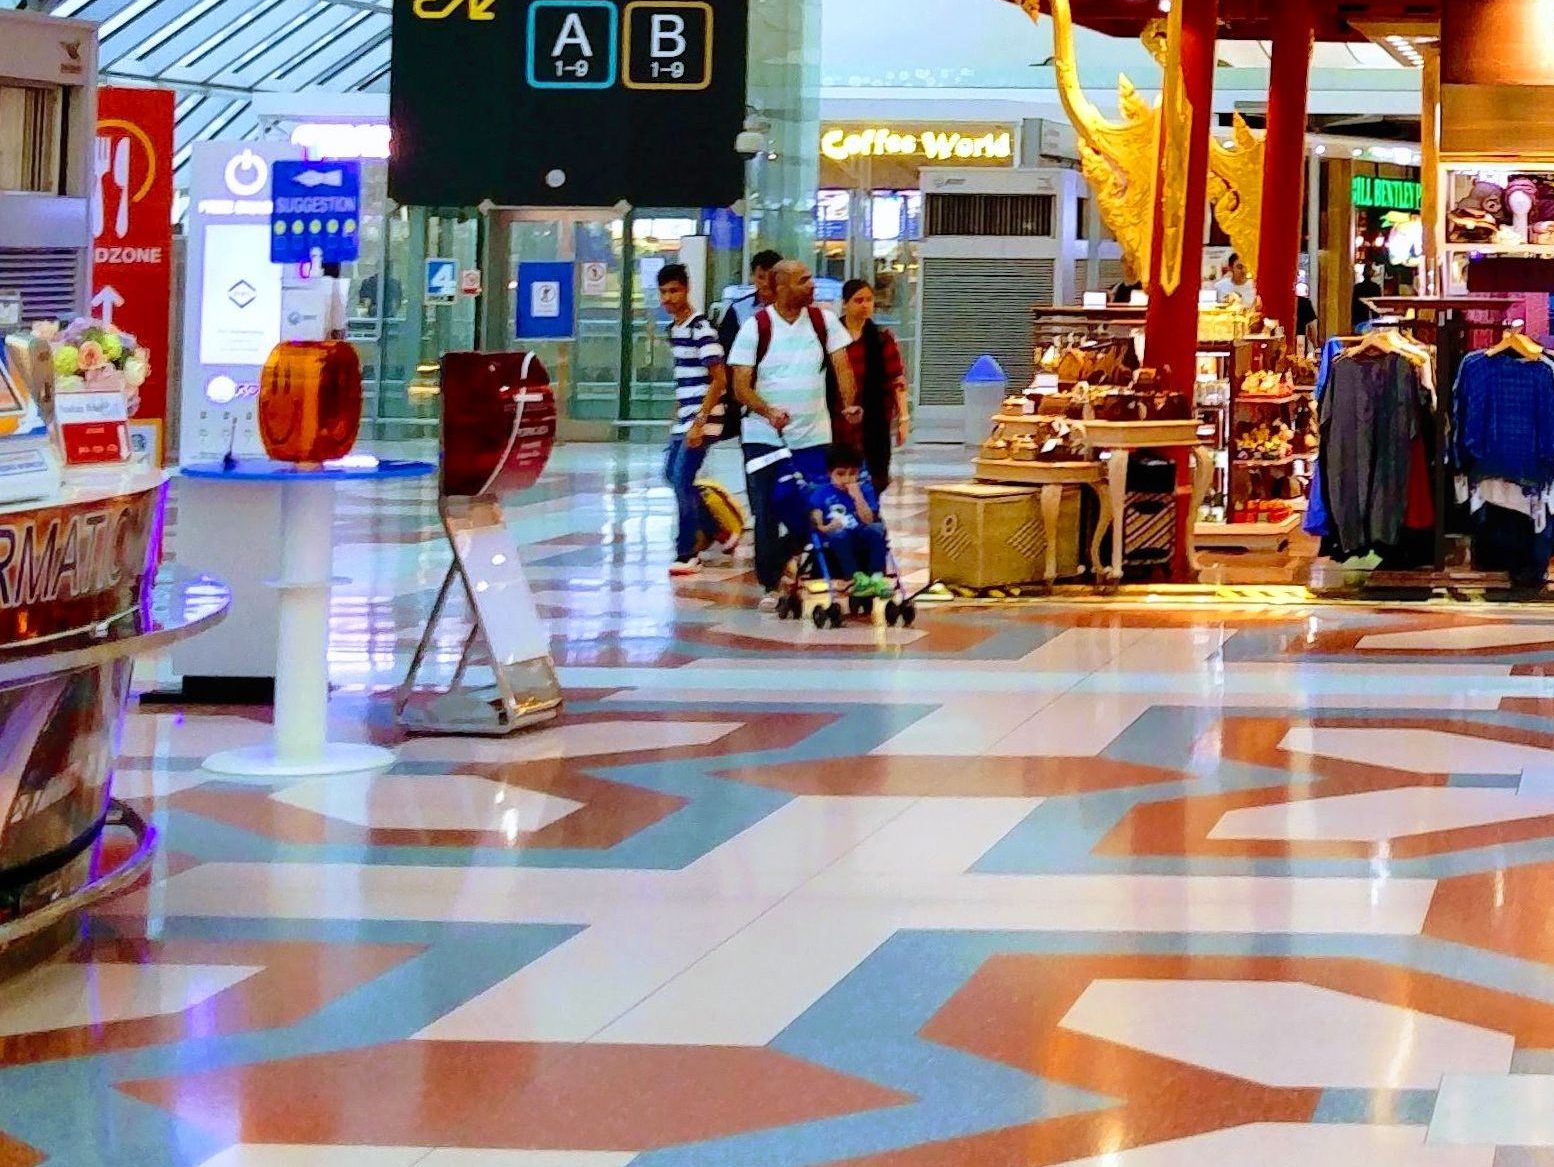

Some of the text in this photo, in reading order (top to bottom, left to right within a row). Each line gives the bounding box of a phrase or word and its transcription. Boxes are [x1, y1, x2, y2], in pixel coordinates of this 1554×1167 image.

[551, 12, 686, 58] A B
[821, 128, 1011, 160] Coffee World
[275, 196, 357, 213] SUGGESTION
[1374, 178, 1415, 209] BENTLEY
[95, 247, 162, 263] DZONE
[430, 264, 457, 296] 4
